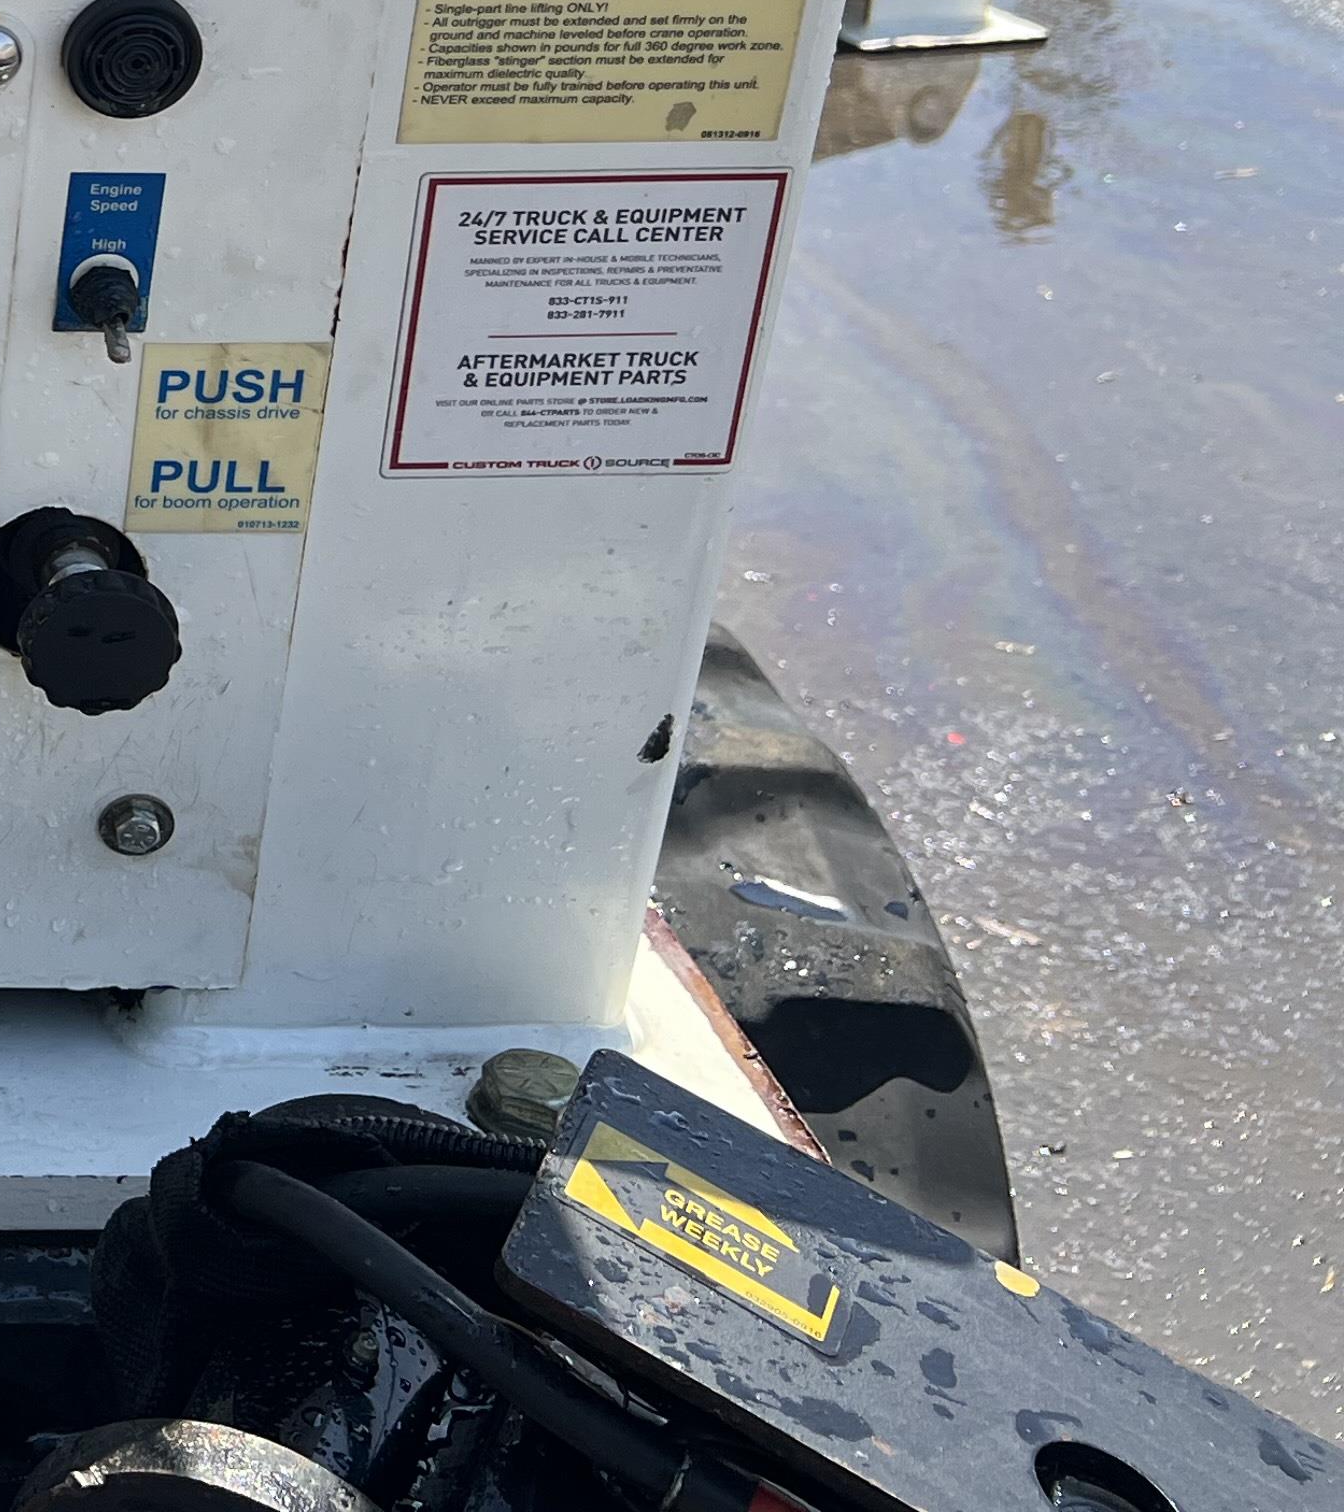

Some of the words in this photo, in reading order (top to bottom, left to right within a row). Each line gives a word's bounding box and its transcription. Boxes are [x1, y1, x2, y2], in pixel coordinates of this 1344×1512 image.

[434, 3, 502, 16] Single-part
[504, 3, 527, 13] line
[530, 2, 563, 15] lifting
[566, 2, 608, 13] ONLY!
[90, 183, 142, 197] Engine
[90, 199, 137, 213] Speed
[458, 210, 507, 227] 24/7
[512, 209, 587, 226] TRUCK
[593, 209, 608, 224] &
[615, 207, 747, 224] EQUIPMENT
[473, 228, 568, 245] SERVICE
[573, 227, 628, 243] CALL
[635, 225, 723, 242] CENTER
[91, 238, 126, 254] High
[157, 369, 304, 404] PUSH
[155, 405, 179, 419] for
[183, 406, 250, 420] chassis
[256, 405, 300, 419] drive
[150, 460, 285, 493] PULL
[134, 494, 157, 508] for
[162, 495, 211, 508] boom
[217, 496, 299, 511] operation
[664, 1189, 780, 1263] GREASE
[659, 1205, 774, 1278] WEEKLY
